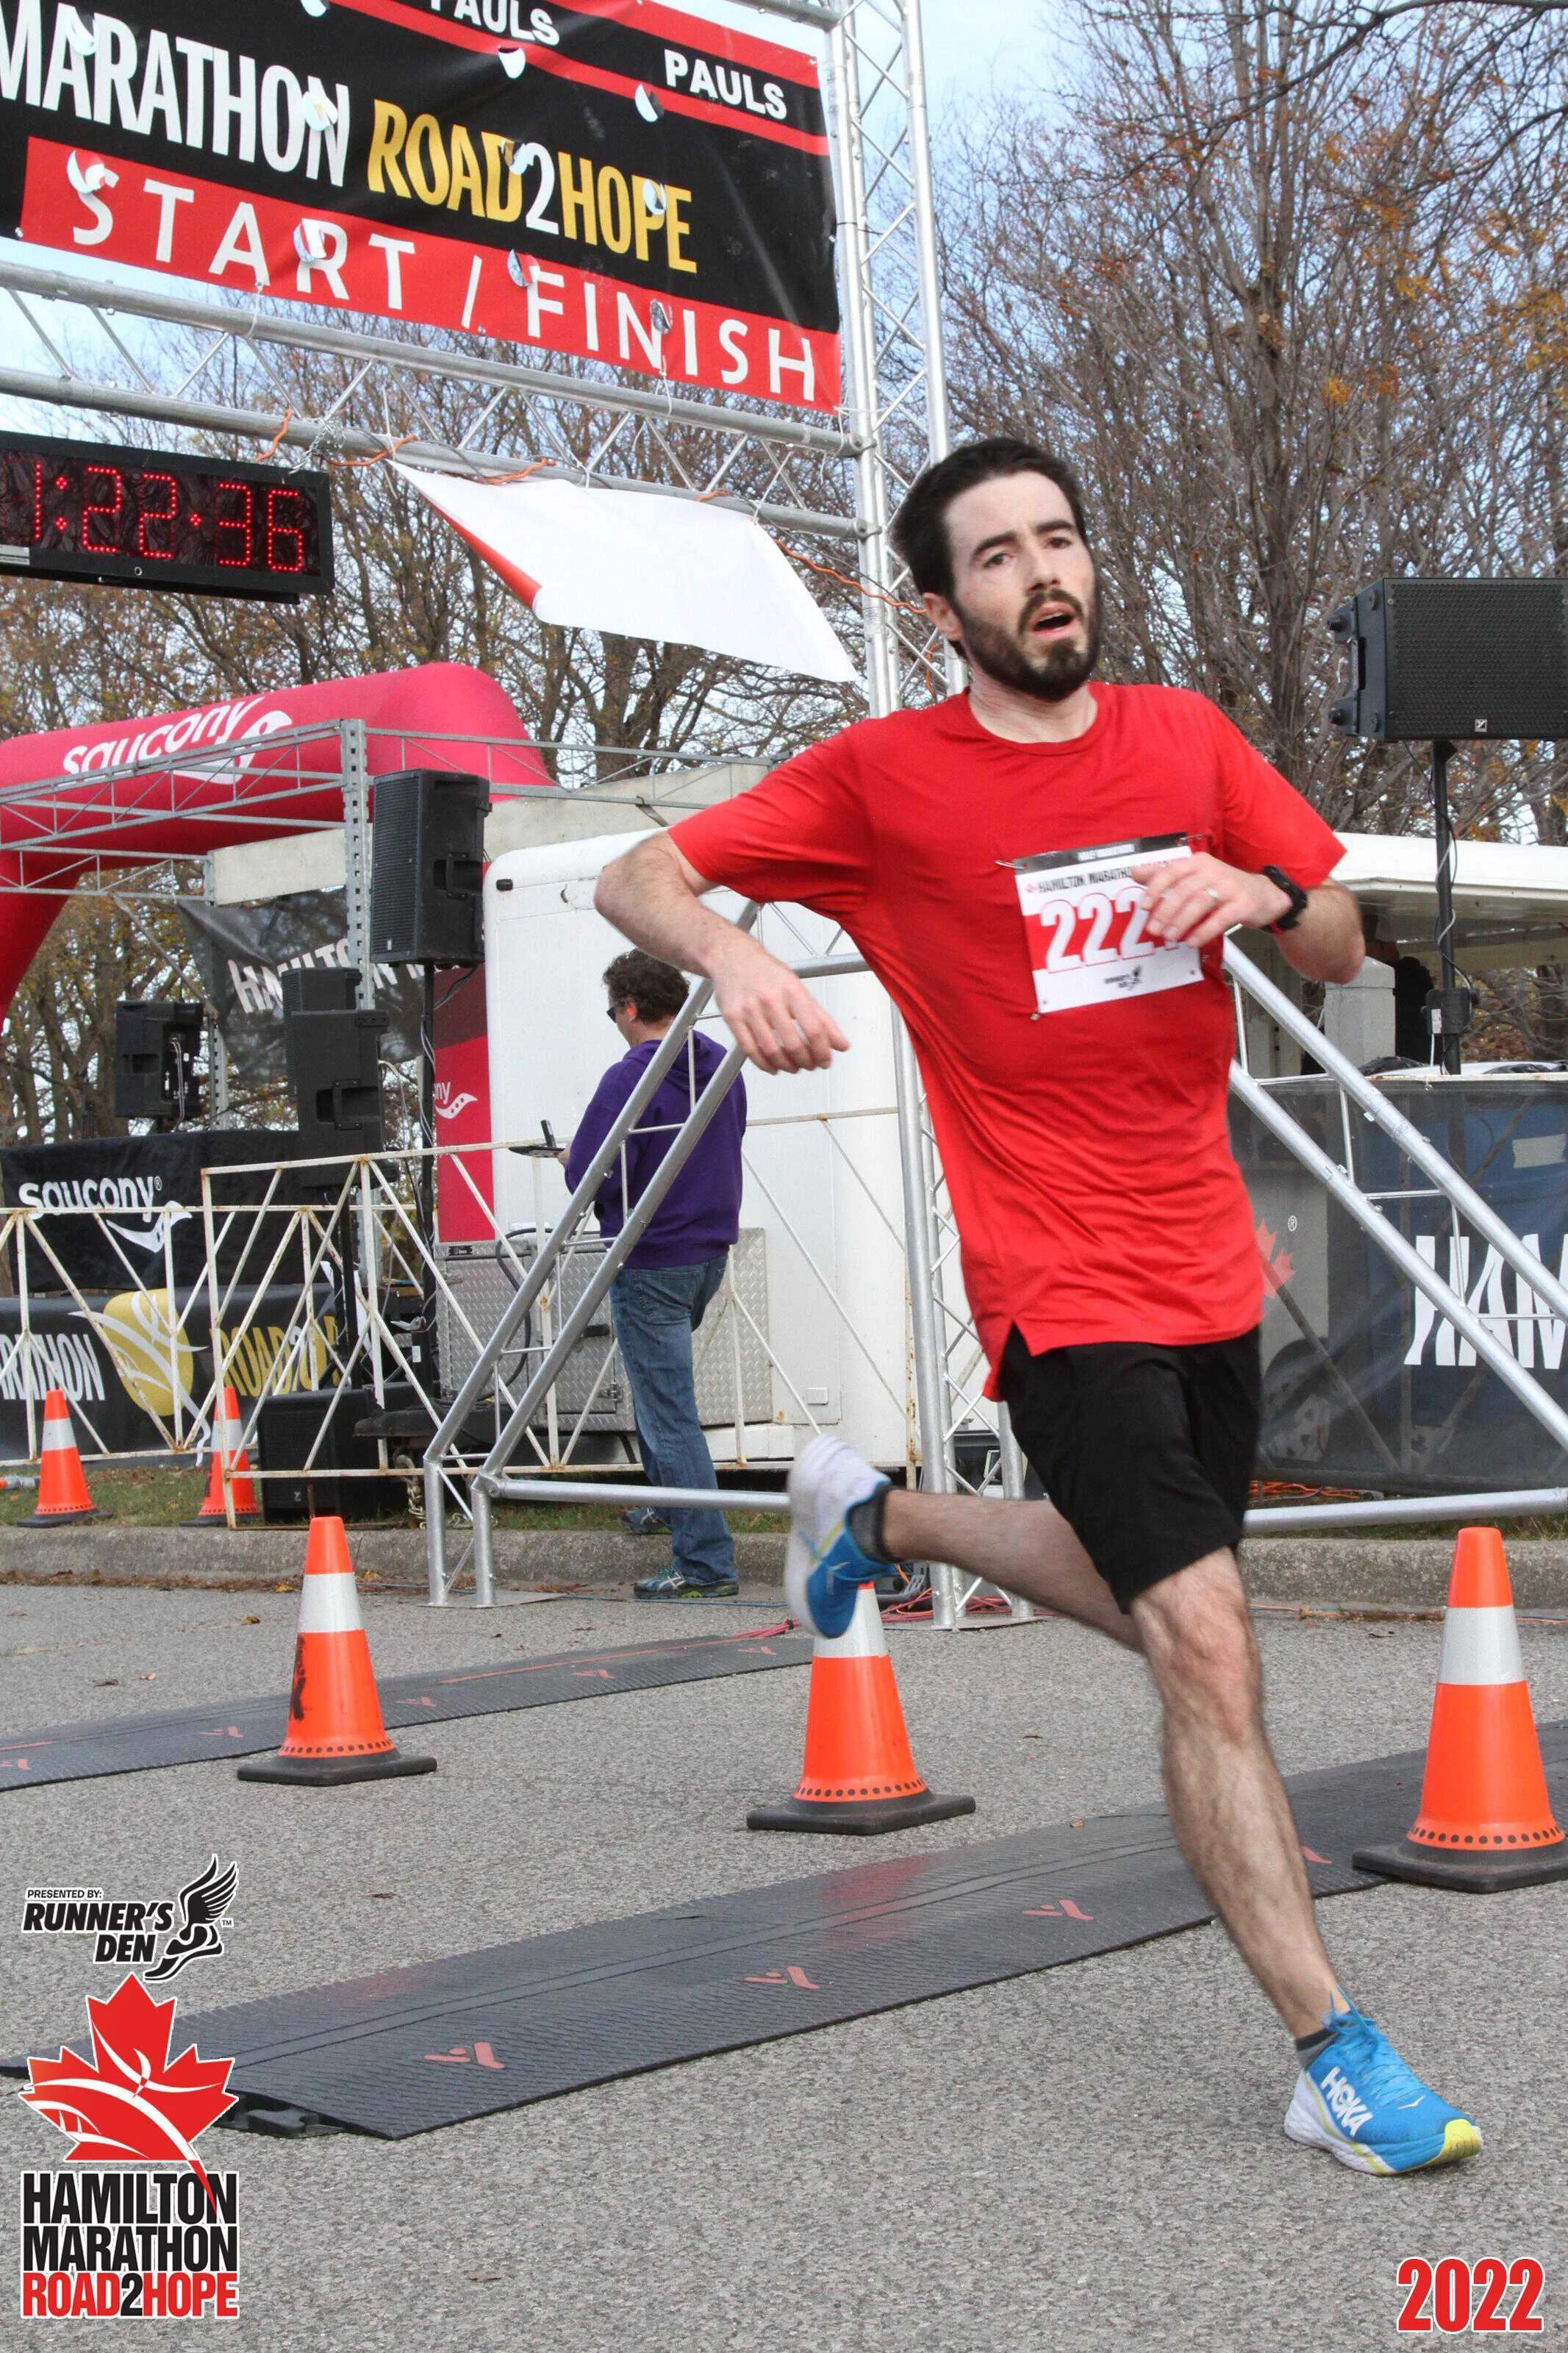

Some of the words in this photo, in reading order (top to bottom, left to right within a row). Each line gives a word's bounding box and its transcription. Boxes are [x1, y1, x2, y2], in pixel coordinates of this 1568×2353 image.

[431, 0, 560, 46] AULS
[0, 0, 351, 188] MARATHON
[664, 49, 787, 120] PAULS
[368, 99, 698, 274] ROAD2HOPE
[67, 150, 415, 310] START
[526, 265, 815, 402] FINISH
[1039, 886, 1179, 974] 222
[0, 1333, 105, 1401] RATHON
[1320, 2065, 1374, 2138] HOKA
